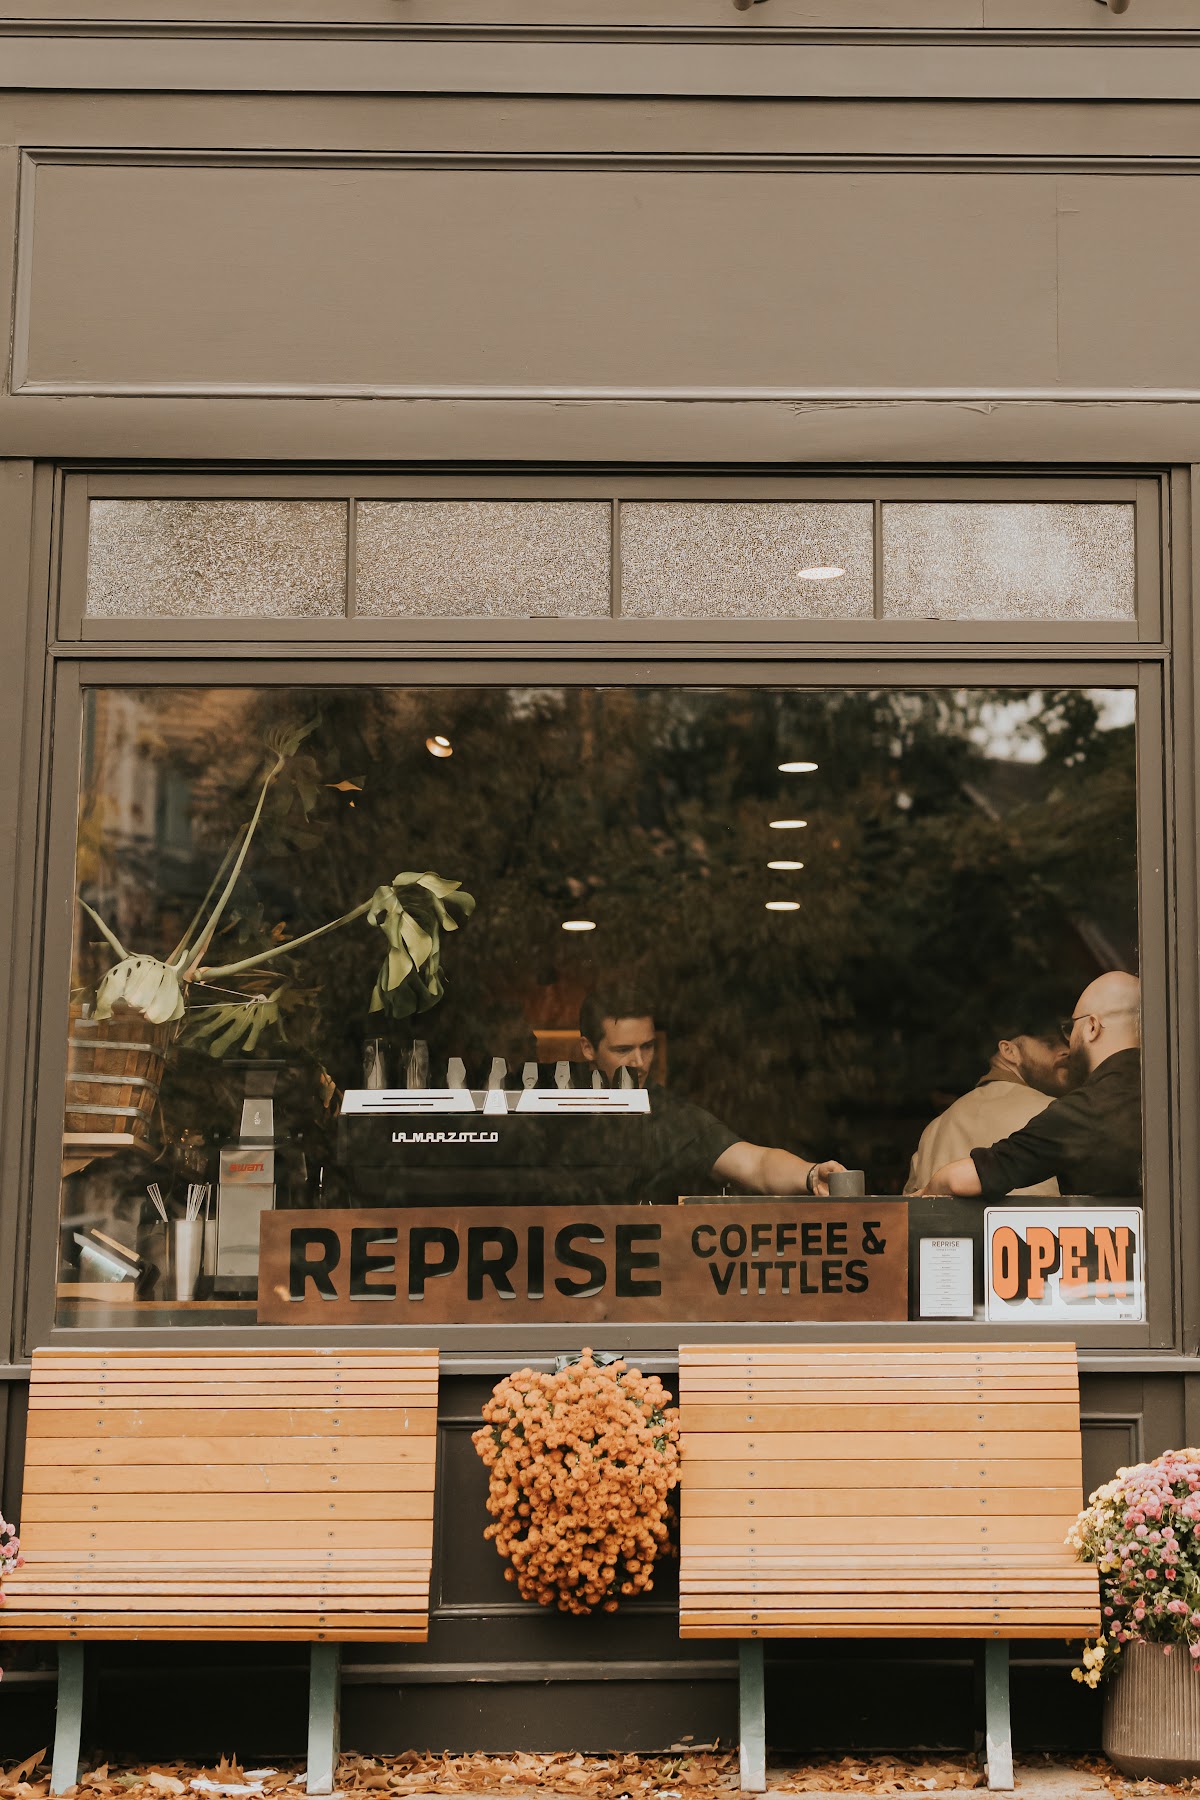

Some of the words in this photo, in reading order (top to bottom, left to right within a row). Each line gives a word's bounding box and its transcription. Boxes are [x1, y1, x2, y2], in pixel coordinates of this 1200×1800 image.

[392, 1132, 407, 1142] LA
[412, 1132, 499, 1142] MARZOCCO
[691, 1222, 848, 1258] COFFEE
[861, 1221, 887, 1255] &
[289, 1223, 662, 1302] REPRISE
[708, 1259, 869, 1296] VITTLES
[992, 1226, 1133, 1302] OPEN
